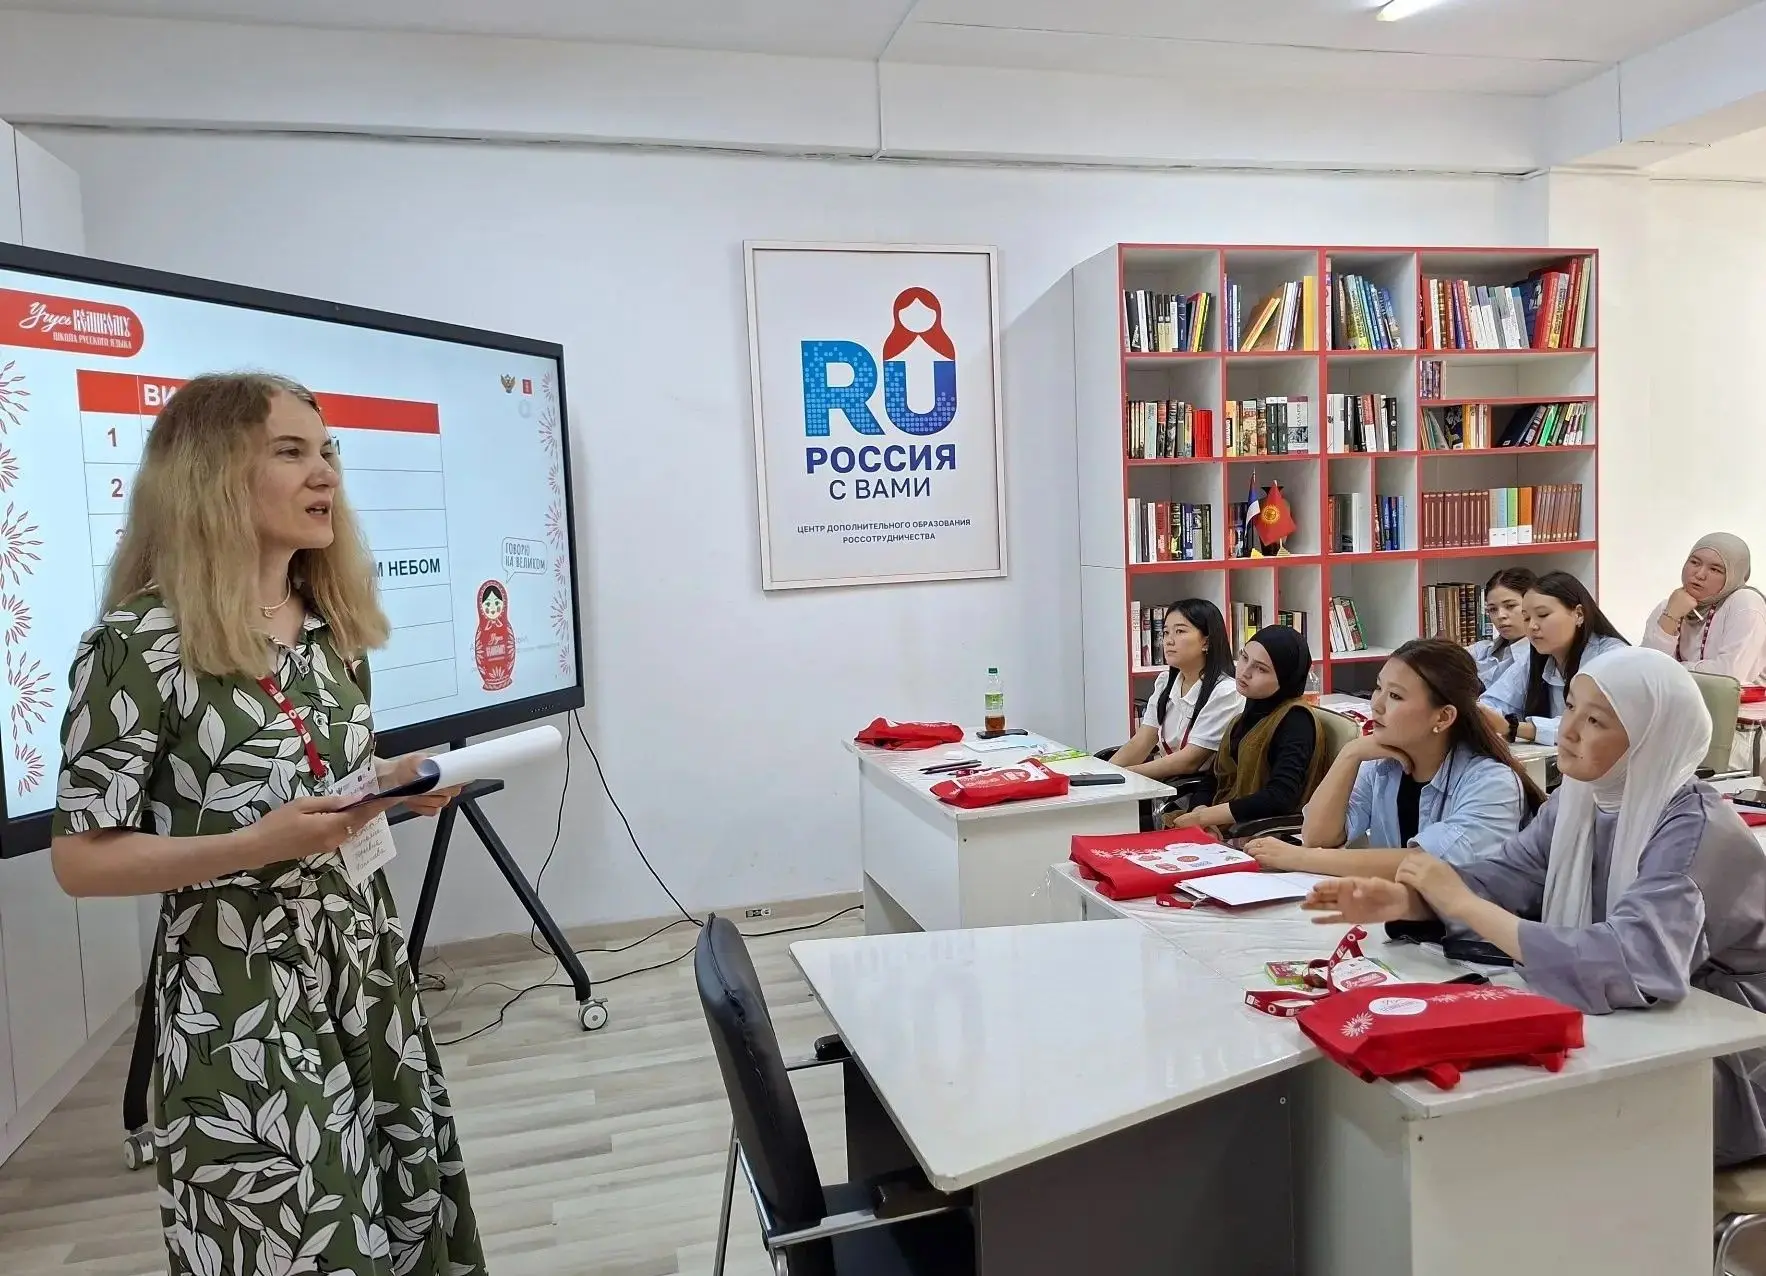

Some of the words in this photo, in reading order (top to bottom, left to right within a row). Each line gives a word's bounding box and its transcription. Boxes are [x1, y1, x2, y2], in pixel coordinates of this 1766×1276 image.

[53, 332, 78, 343] ШКОЛА
[78, 334, 109, 347] РУССКОГО
[110, 338, 132, 349] ЯЗЫКА
[800, 339, 958, 437] RU
[107, 427, 117, 447] 1
[805, 443, 957, 475] РОССИЯ
[111, 478, 124, 498] 2
[829, 479, 847, 500] С
[855, 477, 932, 499] ВАМИ
[797, 525, 826, 534] ЦЕНТР
[827, 521, 911, 533] ДОПОЛНИТЕЛЬНОГО
[912, 519, 971, 528] ОБРАЗОВАНИЯ
[843, 533, 936, 544] РОССОТРУДНИЧЕСТВА
[505, 543, 530, 556] ГОВОРЮ
[388, 558, 440, 577] НЕБОМ
[516, 557, 545, 570] ВЕЛИКОМ
